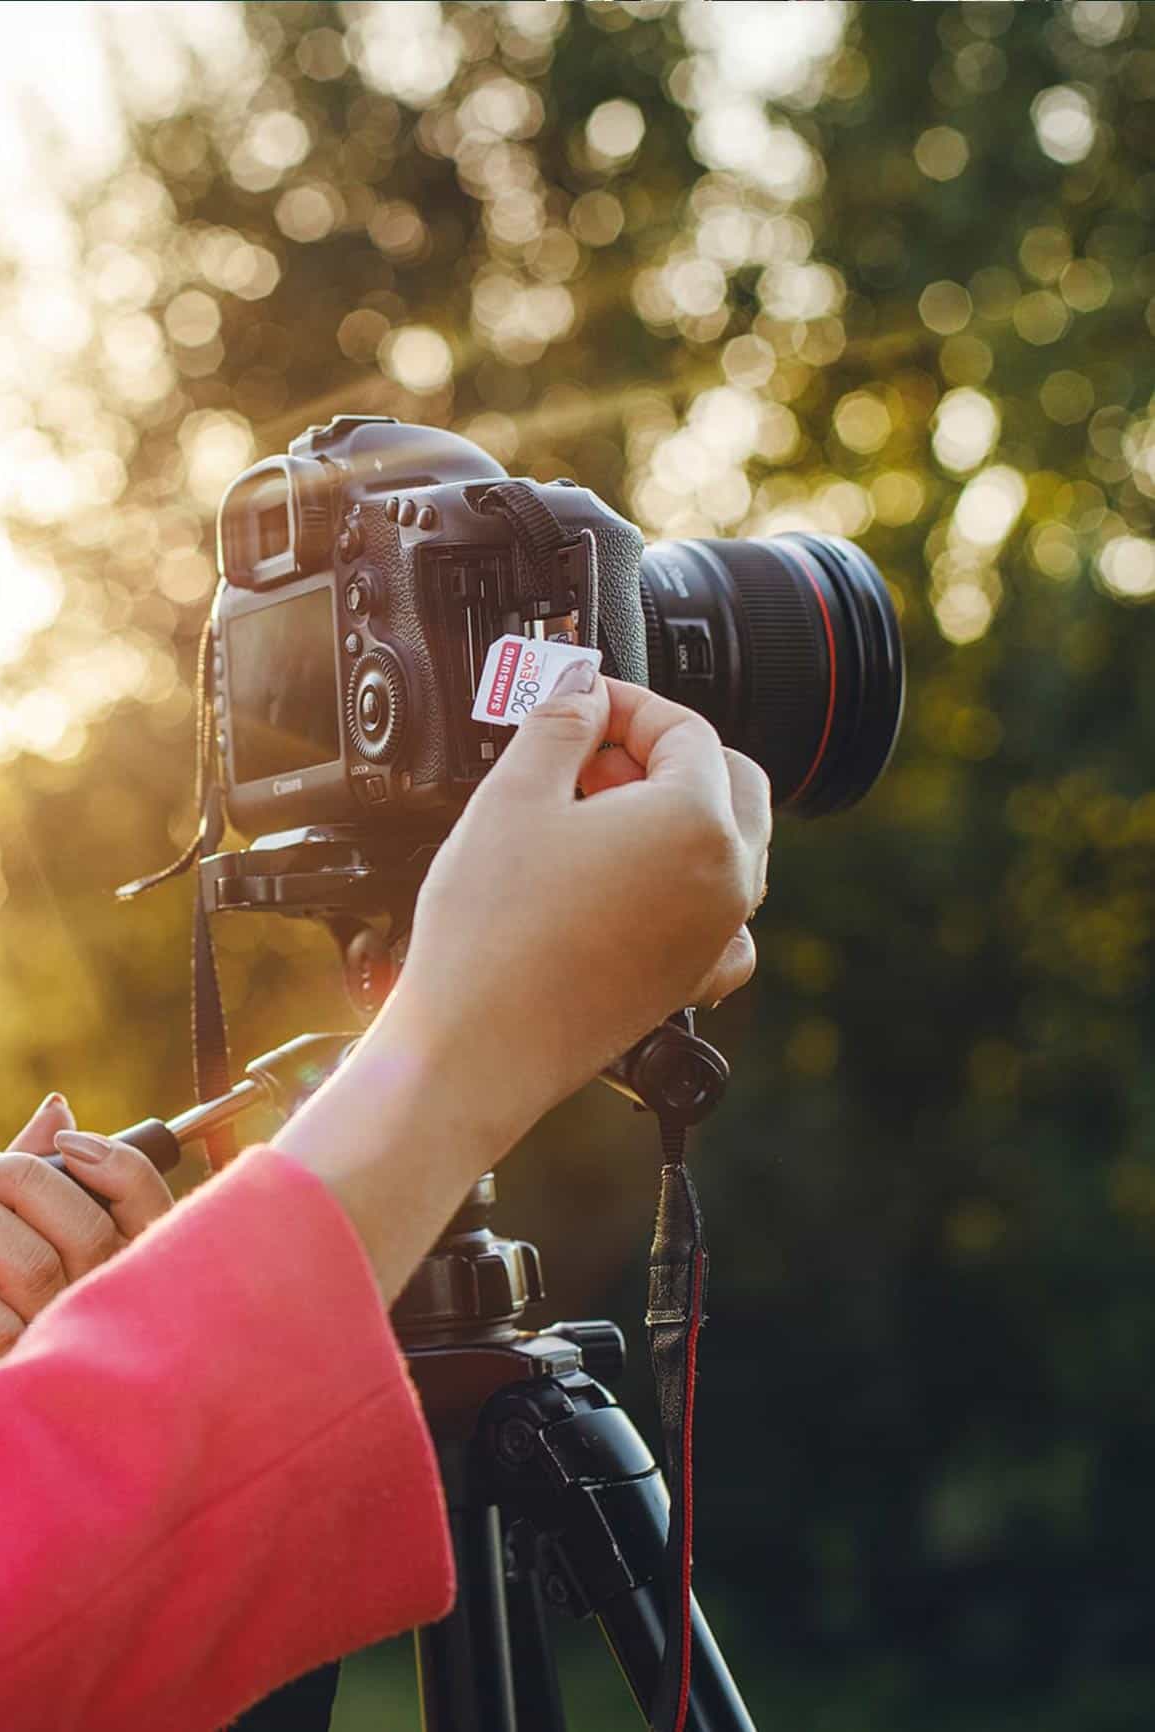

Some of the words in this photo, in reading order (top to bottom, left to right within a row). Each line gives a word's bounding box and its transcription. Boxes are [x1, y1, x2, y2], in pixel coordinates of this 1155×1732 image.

[491, 648, 516, 711] SAMSUNG
[520, 651, 536, 680] EVO
[510, 680, 540, 713] 256
